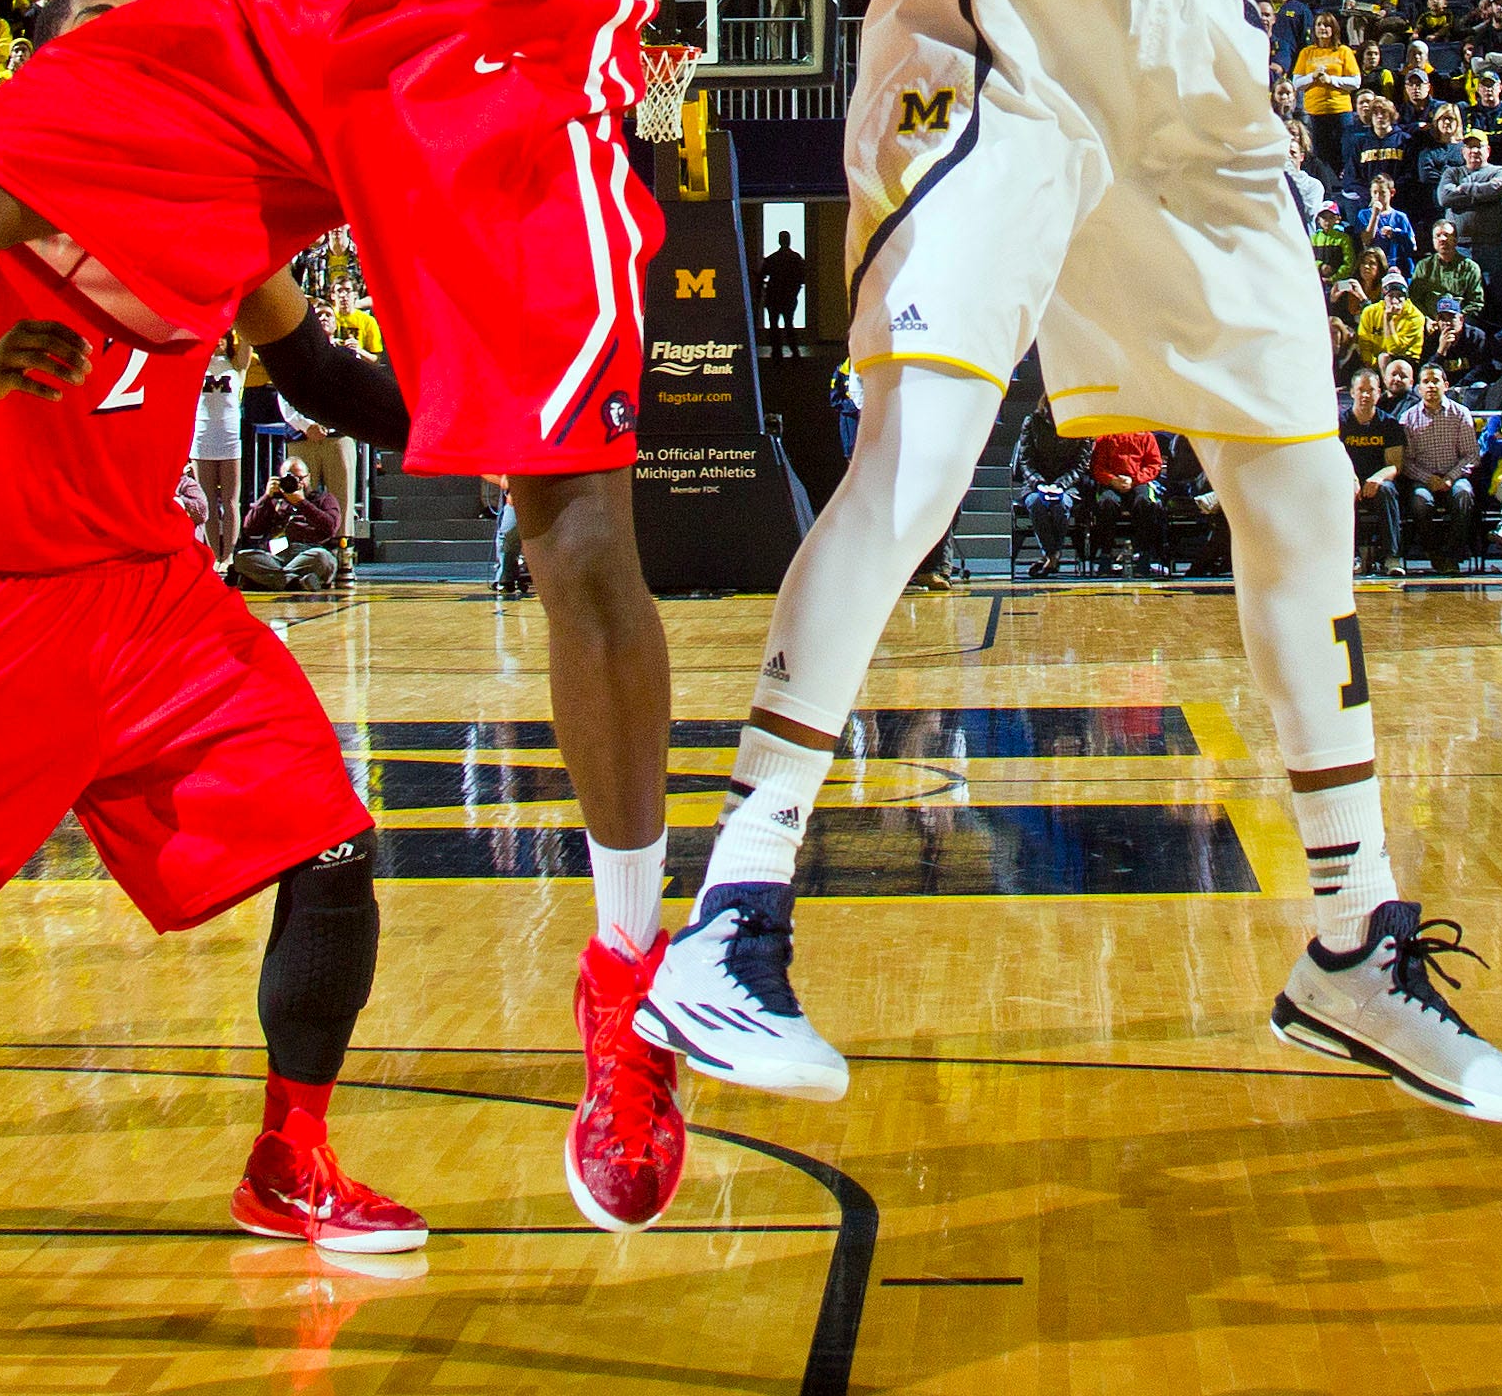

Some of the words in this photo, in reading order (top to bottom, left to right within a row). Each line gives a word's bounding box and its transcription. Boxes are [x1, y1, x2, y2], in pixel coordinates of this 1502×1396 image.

[897, 87, 956, 134] M
[675, 269, 716, 299] M
[889, 319, 929, 332] adidas
[651, 341, 738, 363] Flagstar
[703, 363, 733, 375] Bank
[202, 375, 232, 393] M
[658, 391, 732, 405] flagstar.com
[636, 449, 654, 461] An
[657, 448, 705, 461] Official
[708, 448, 756, 461] Partner
[636, 466, 696, 483] Michigan
[699, 466, 756, 479] Athletics
[670, 486, 702, 494] Member
[702, 486, 721, 494] FDIC
[763, 667, 791, 683] adidas
